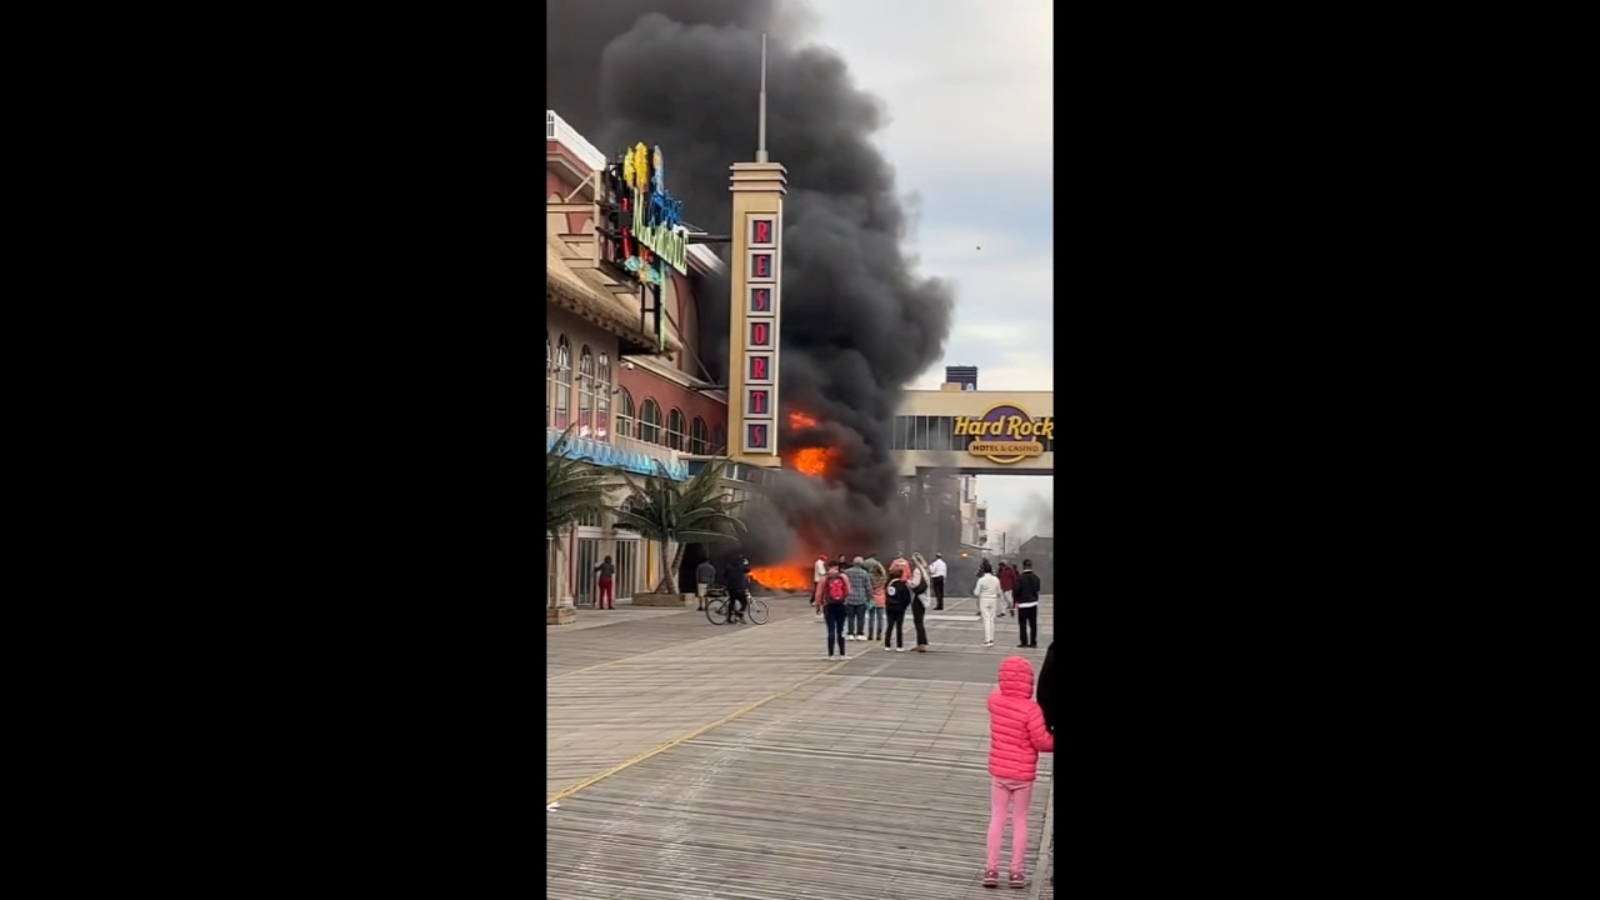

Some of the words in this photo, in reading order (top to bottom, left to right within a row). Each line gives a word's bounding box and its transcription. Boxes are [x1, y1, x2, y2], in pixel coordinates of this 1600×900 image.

[752, 221, 768, 446] RESORTS
[954, 415, 1005, 435] Hard
[1007, 415, 1054, 439] Rock
[1008, 444, 1039, 452] CASINO
